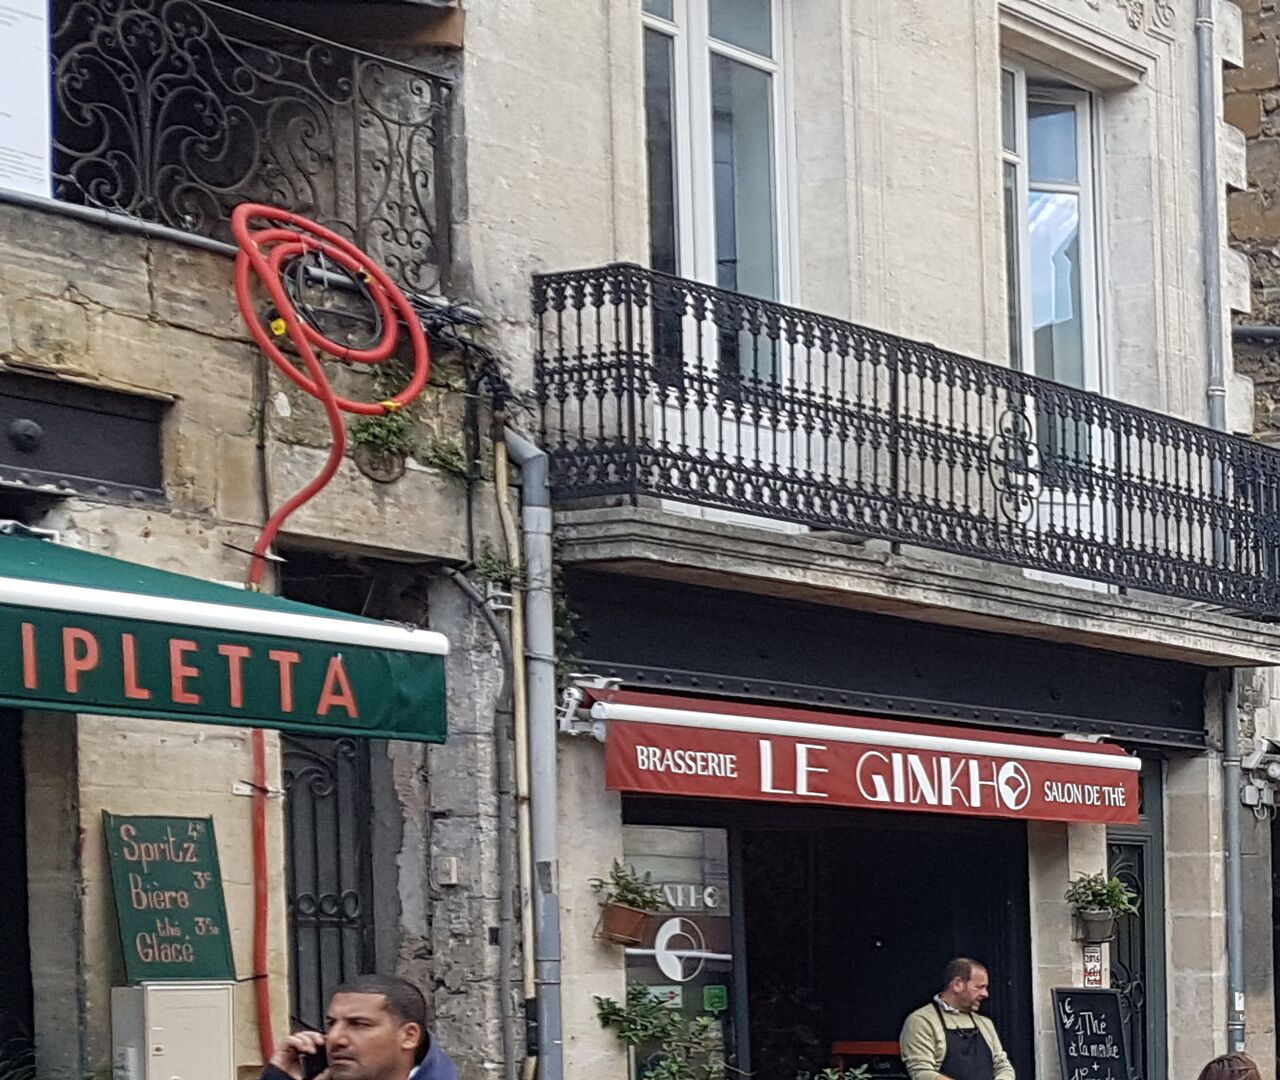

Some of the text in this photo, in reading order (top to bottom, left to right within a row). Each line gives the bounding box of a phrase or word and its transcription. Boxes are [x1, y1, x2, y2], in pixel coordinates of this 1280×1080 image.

[636, 745, 738, 778] BRASSERIE
[759, 739, 1031, 810] LE GINKHO
[1044, 780, 1126, 807] SALON DE THÉ
[119, 823, 197, 874] Spritz
[128, 872, 190, 910] Bière
[135, 931, 194, 962] Glacé
